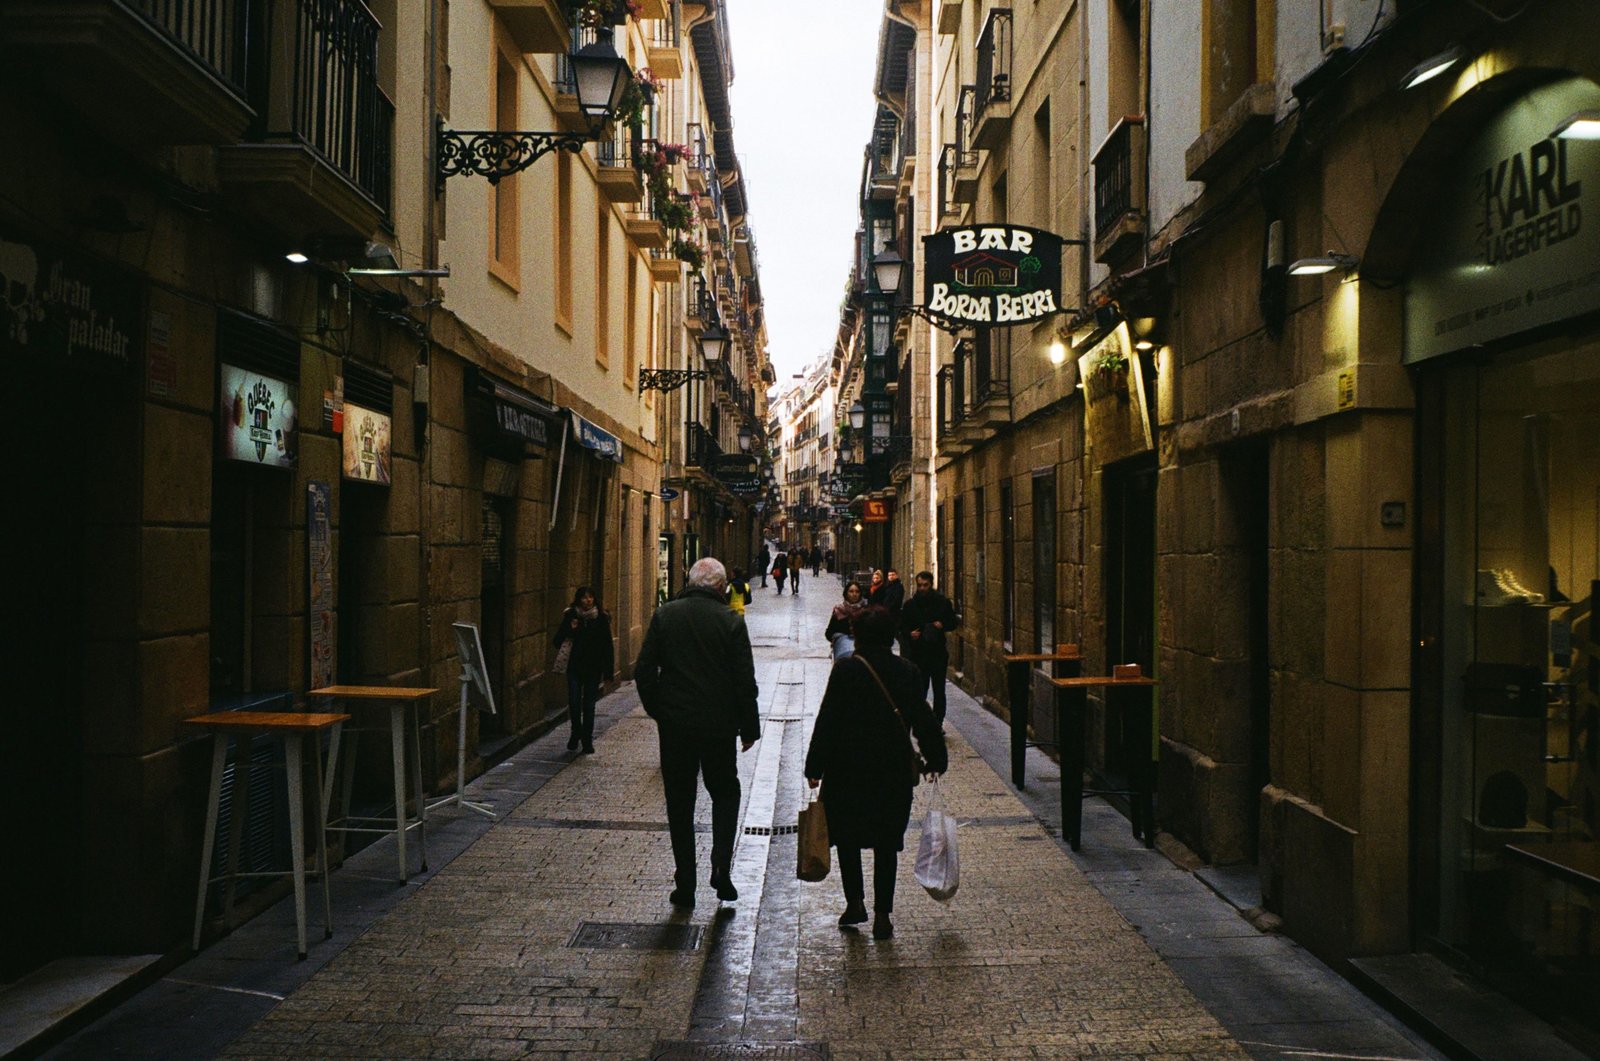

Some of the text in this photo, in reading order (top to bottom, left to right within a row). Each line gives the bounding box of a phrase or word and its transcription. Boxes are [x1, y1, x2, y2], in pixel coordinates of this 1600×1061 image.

[1486, 138, 1582, 236] KARL
[952, 228, 1033, 255] BAR
[1487, 202, 1581, 266] LAGERFELD
[49, 259, 91, 311] Gran
[928, 282, 991, 322] BORDA
[68, 309, 130, 359] paladar
